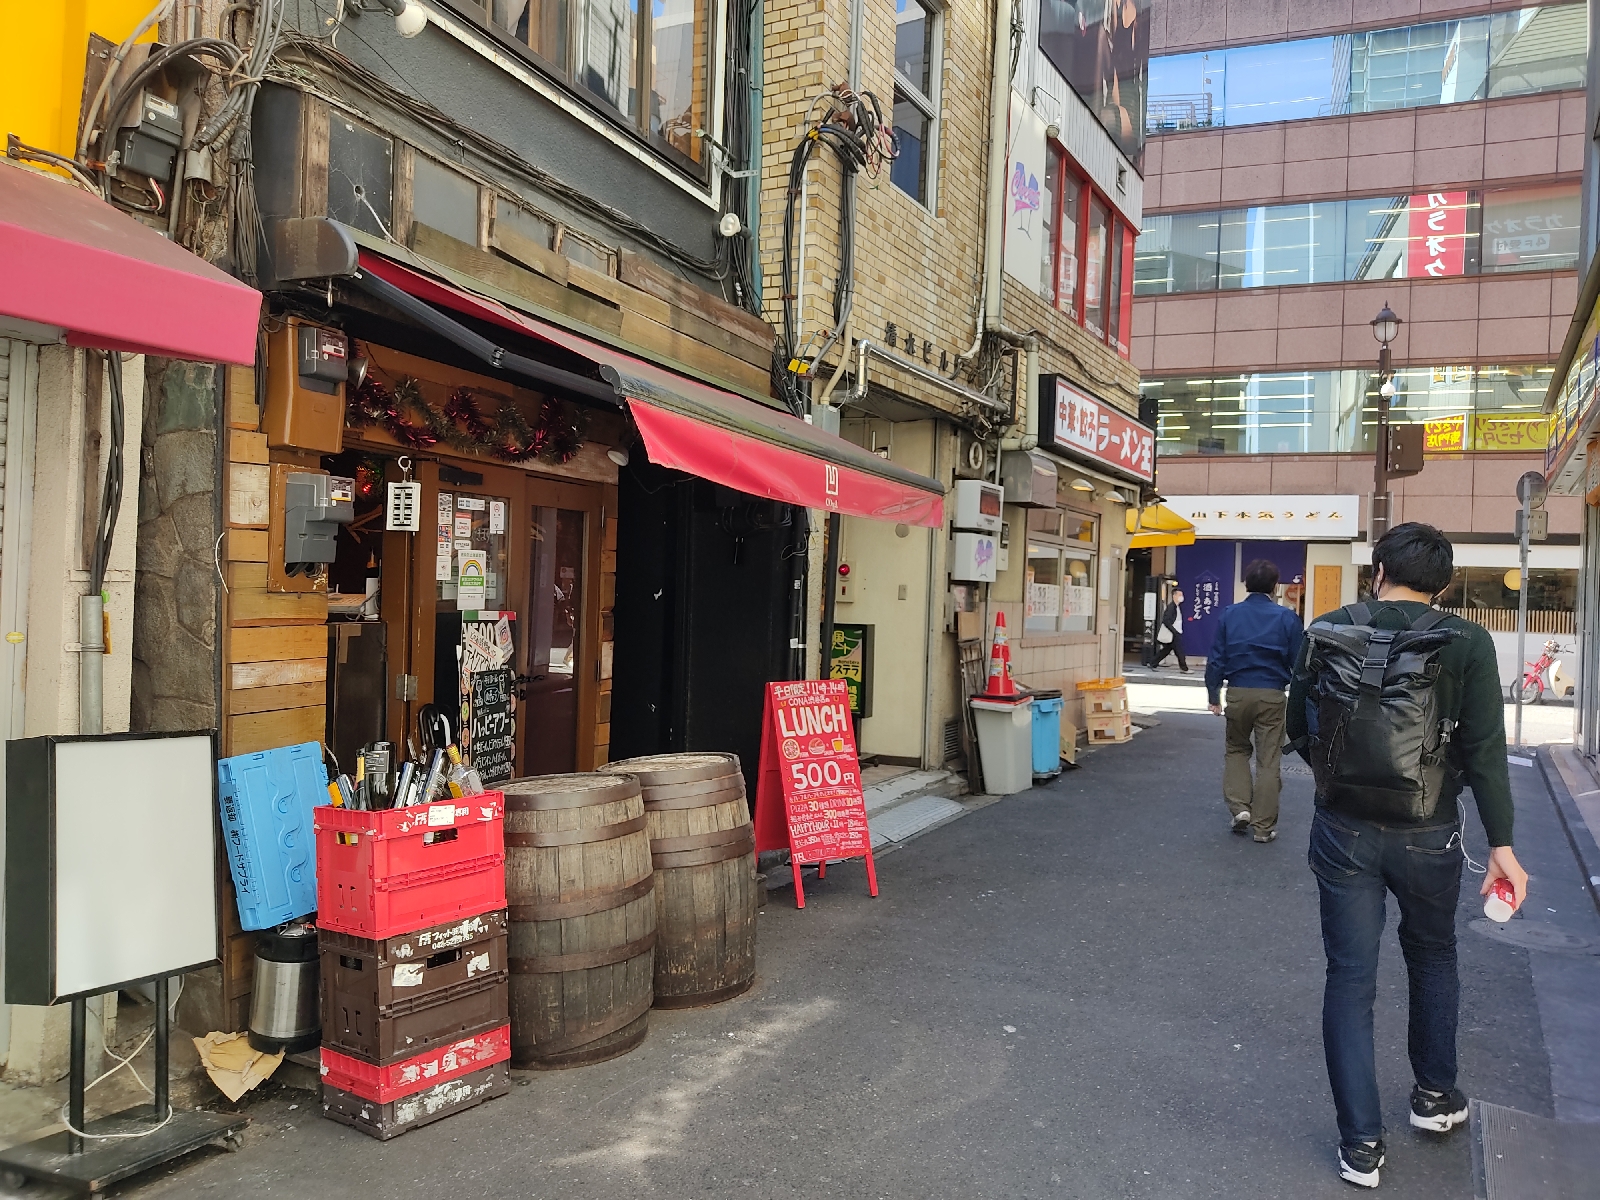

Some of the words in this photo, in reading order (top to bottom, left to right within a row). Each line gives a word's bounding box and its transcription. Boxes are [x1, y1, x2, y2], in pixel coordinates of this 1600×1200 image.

[471, 712, 510, 738] ハッピーアワー
[777, 704, 848, 738] LUNCH
